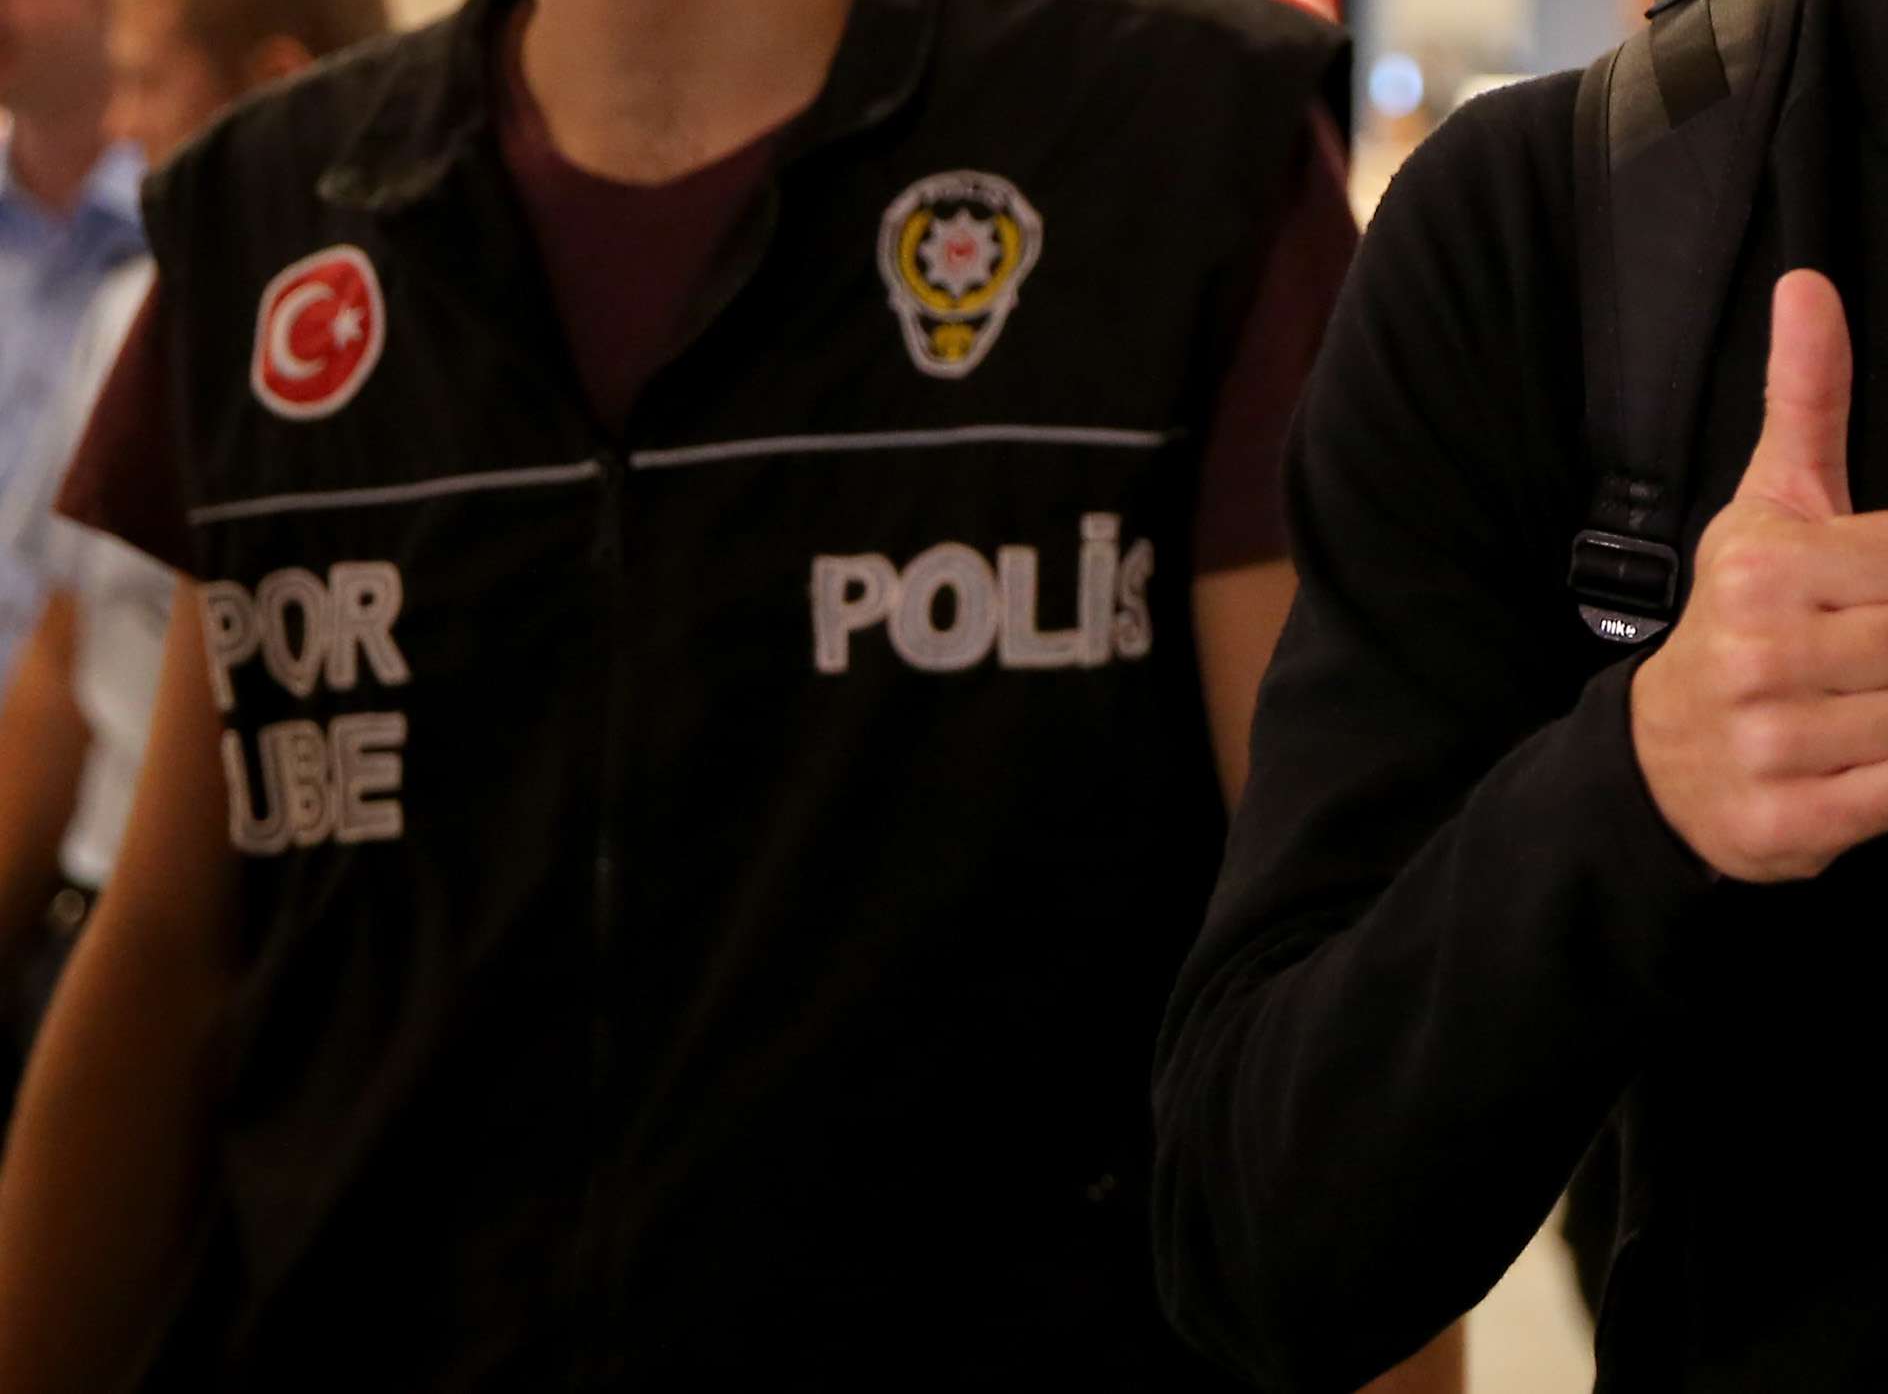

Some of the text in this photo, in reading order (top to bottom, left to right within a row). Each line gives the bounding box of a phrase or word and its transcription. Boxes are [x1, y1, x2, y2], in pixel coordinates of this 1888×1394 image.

[201, 561, 411, 710] POR
[811, 511, 1154, 673] POLİS
[222, 712, 407, 853] UBE
